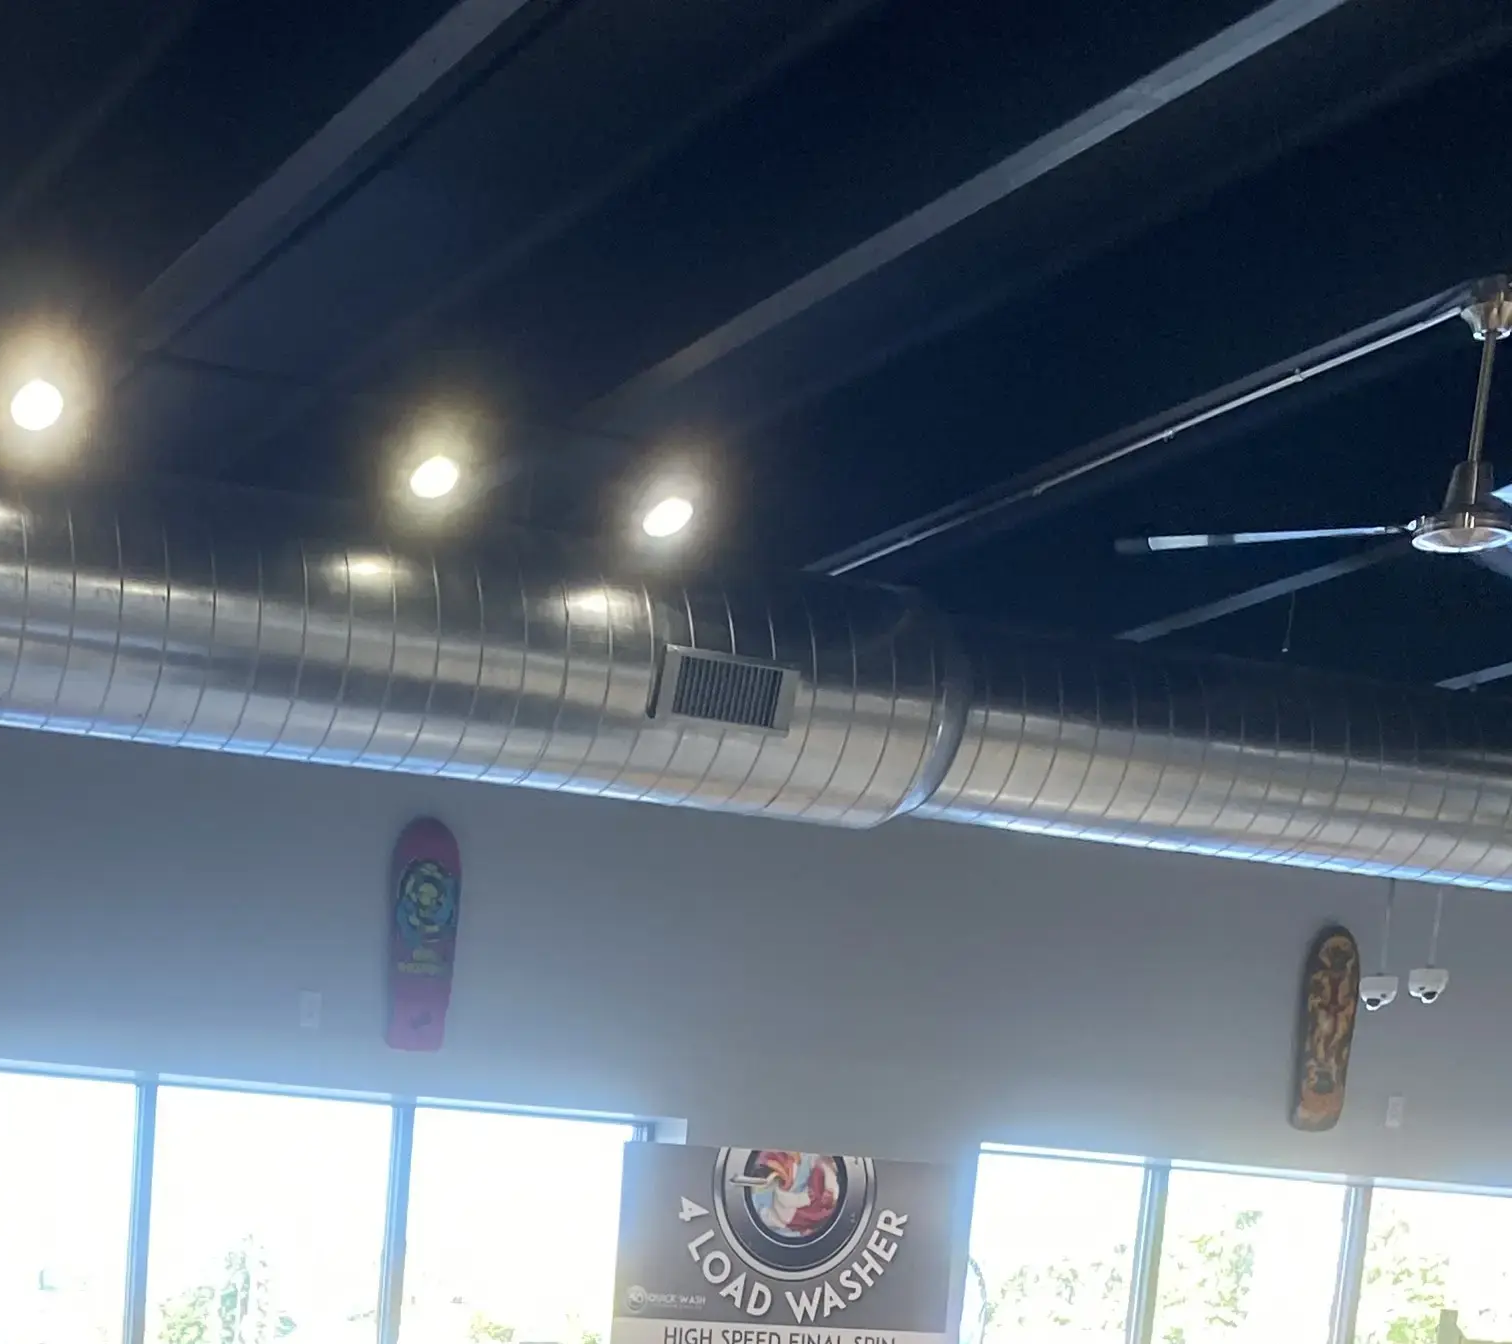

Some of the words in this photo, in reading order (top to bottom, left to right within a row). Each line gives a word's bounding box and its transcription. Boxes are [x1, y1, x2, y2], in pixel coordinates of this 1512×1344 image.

[678, 1196, 710, 1222] 4
[687, 1229, 772, 1318] LOAD
[785, 1207, 909, 1324] WASHER
